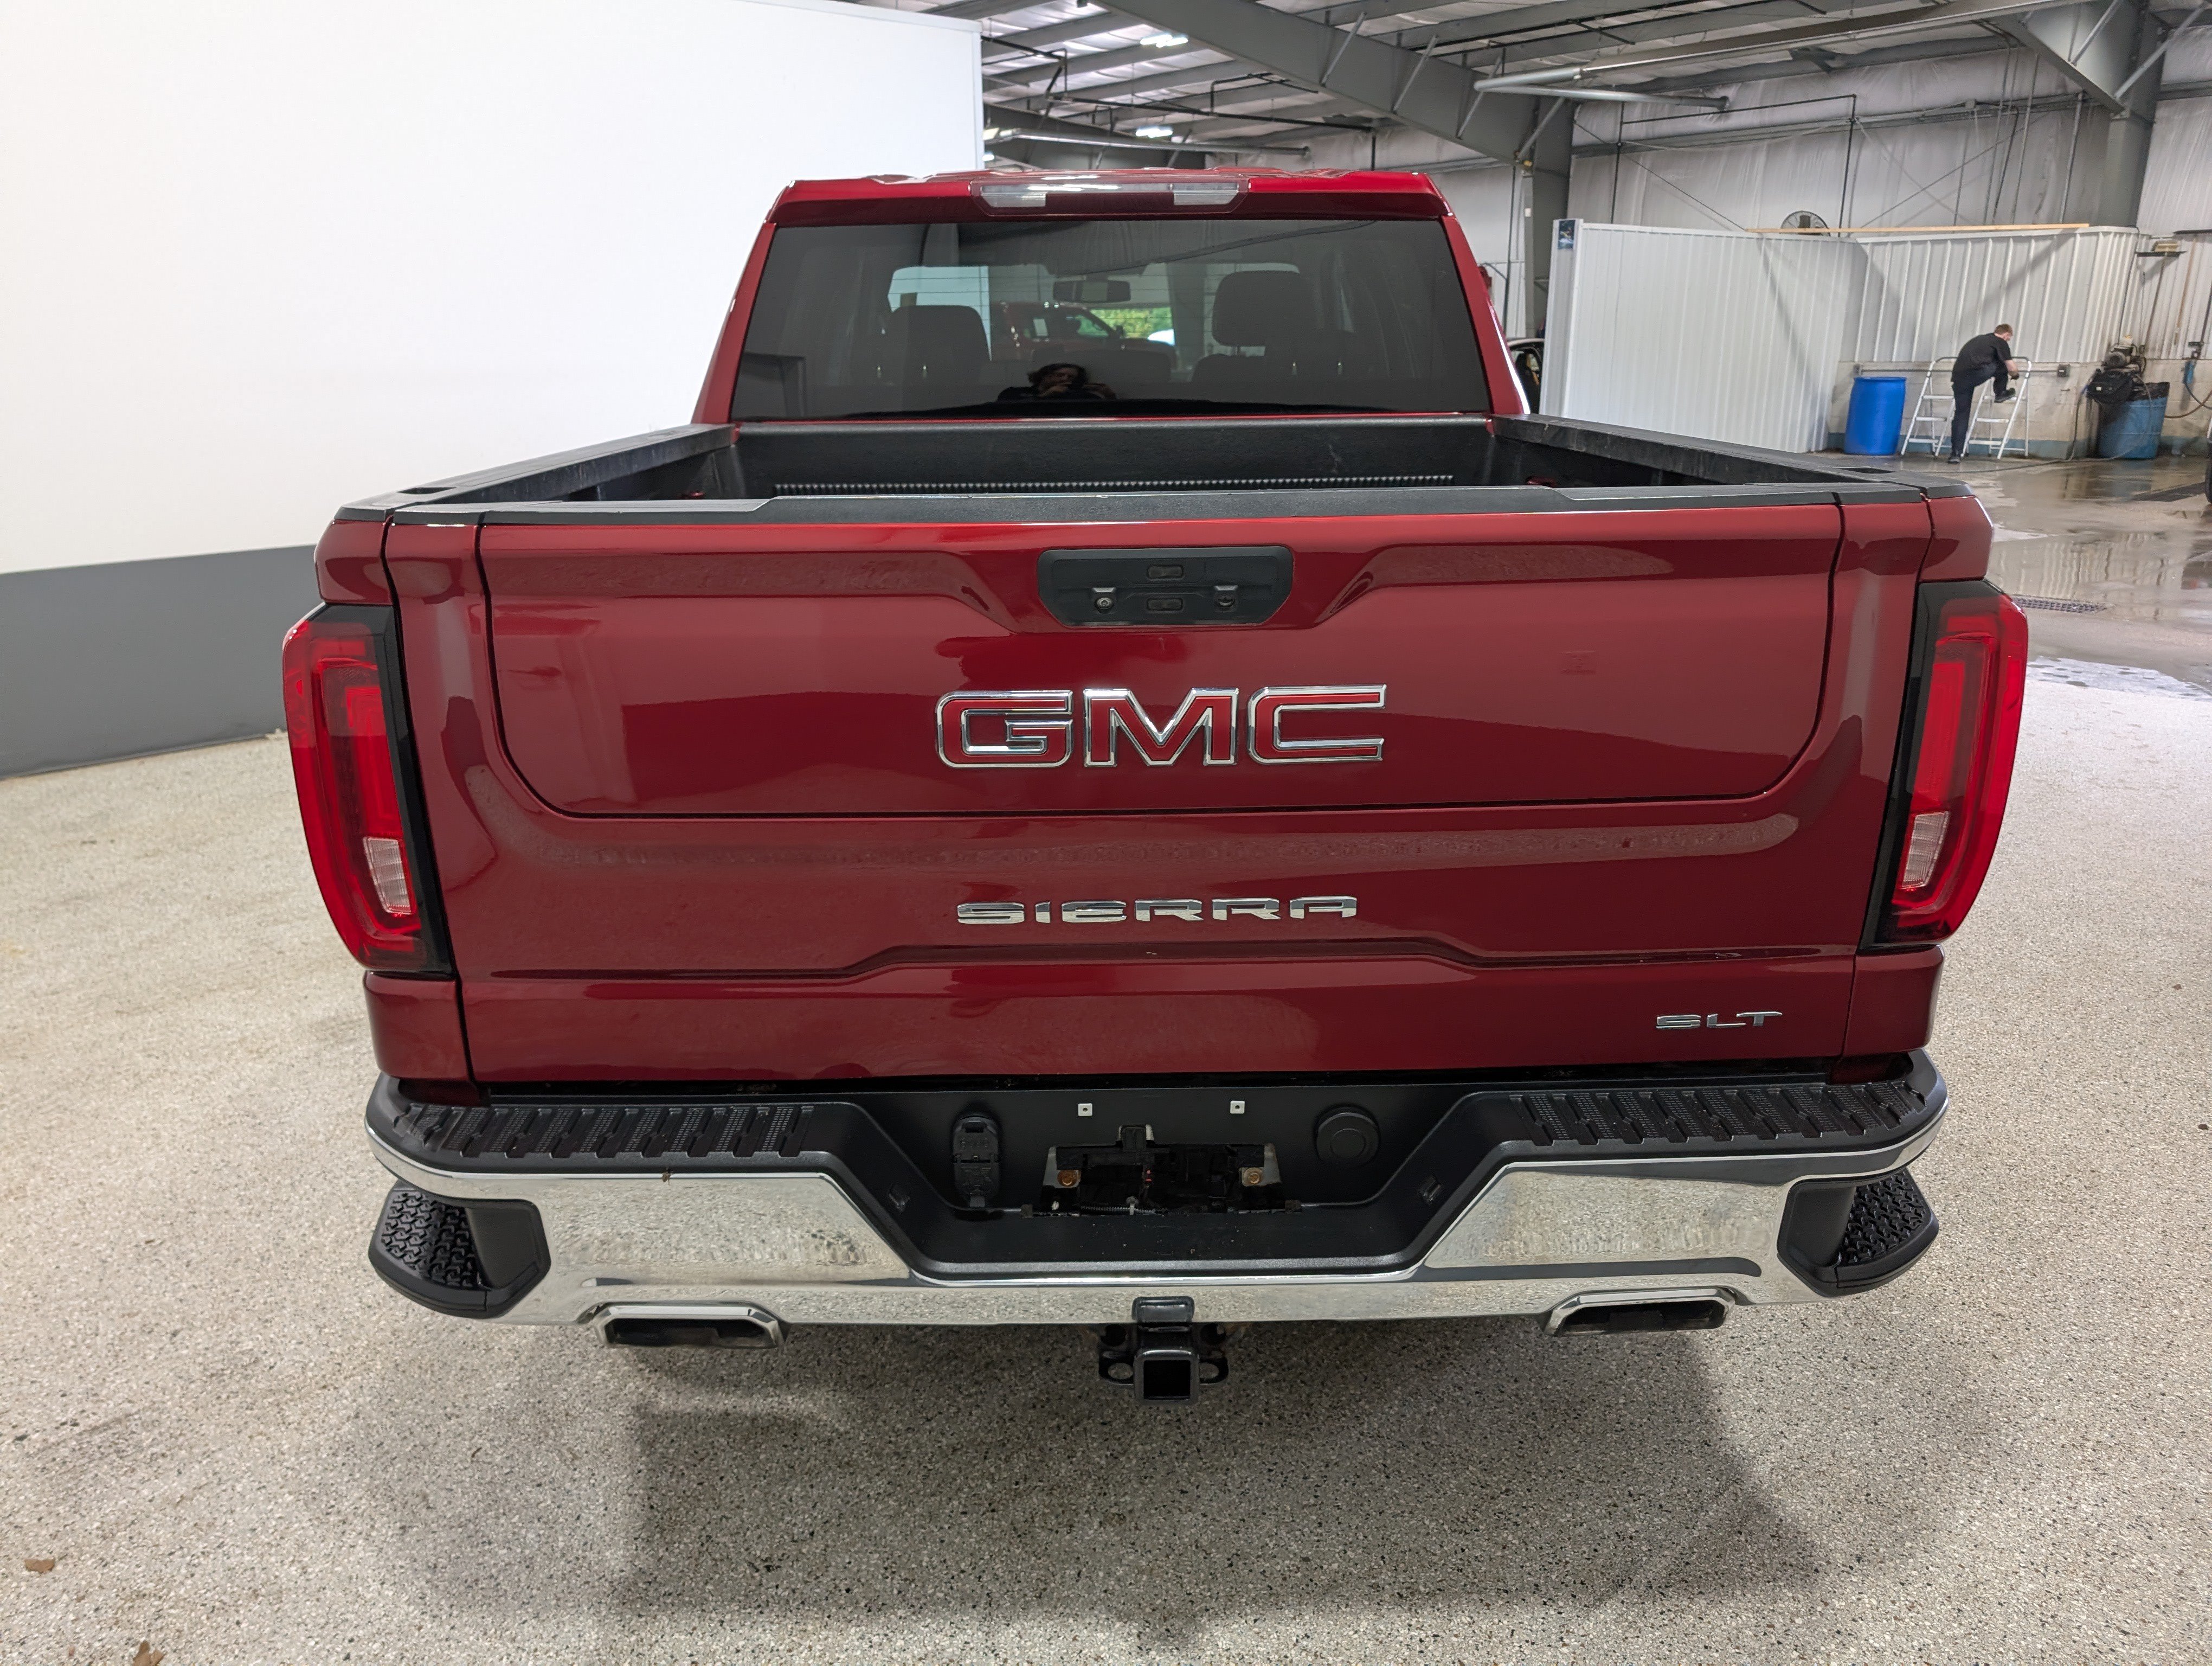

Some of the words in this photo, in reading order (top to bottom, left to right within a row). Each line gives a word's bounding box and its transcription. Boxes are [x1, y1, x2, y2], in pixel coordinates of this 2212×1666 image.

[935, 684, 1387, 768] GMC
[957, 896, 1357, 924] SIERRA
[1656, 1011, 1783, 1028] SLT
